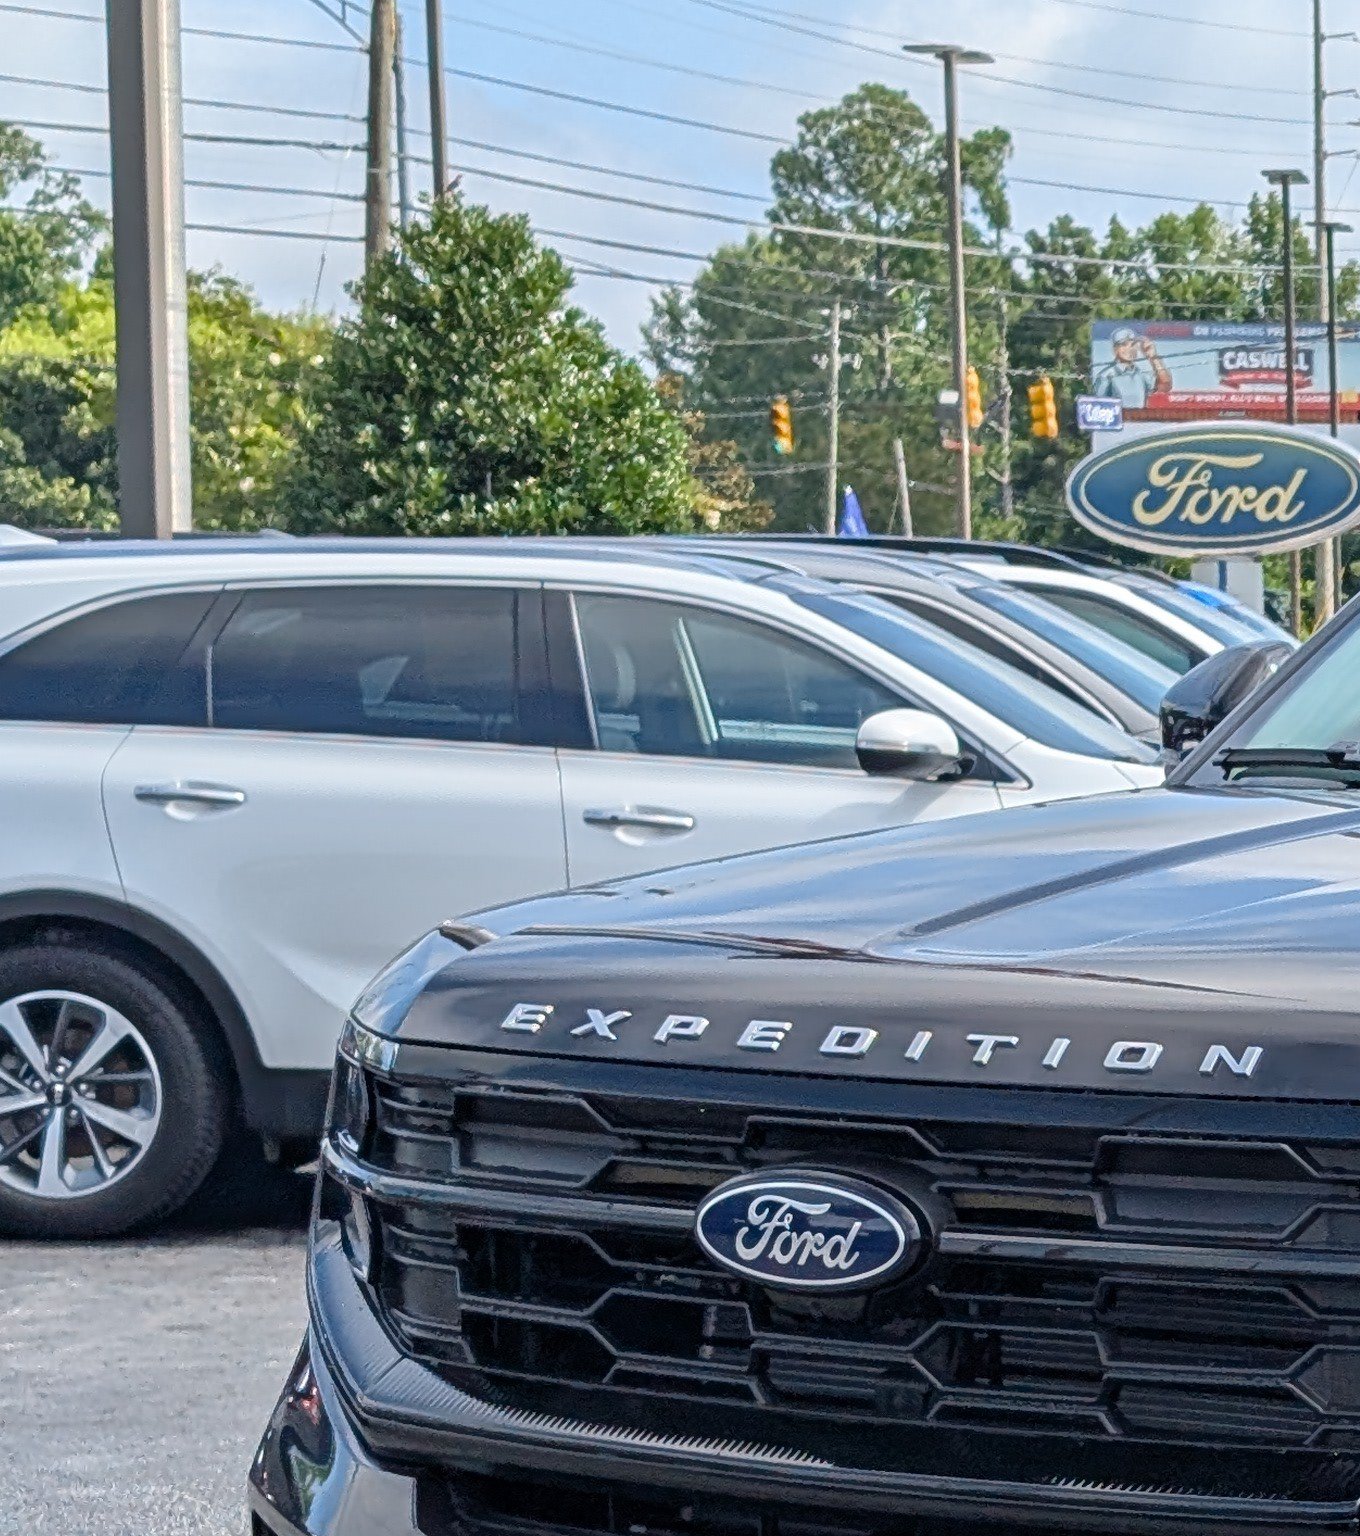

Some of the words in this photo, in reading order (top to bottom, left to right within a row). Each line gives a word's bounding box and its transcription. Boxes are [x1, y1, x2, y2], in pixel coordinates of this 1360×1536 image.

[1132, 452, 1307, 525] Ford
[501, 1002, 1264, 1078] EXPEDITION
[735, 1193, 863, 1272] Ford
